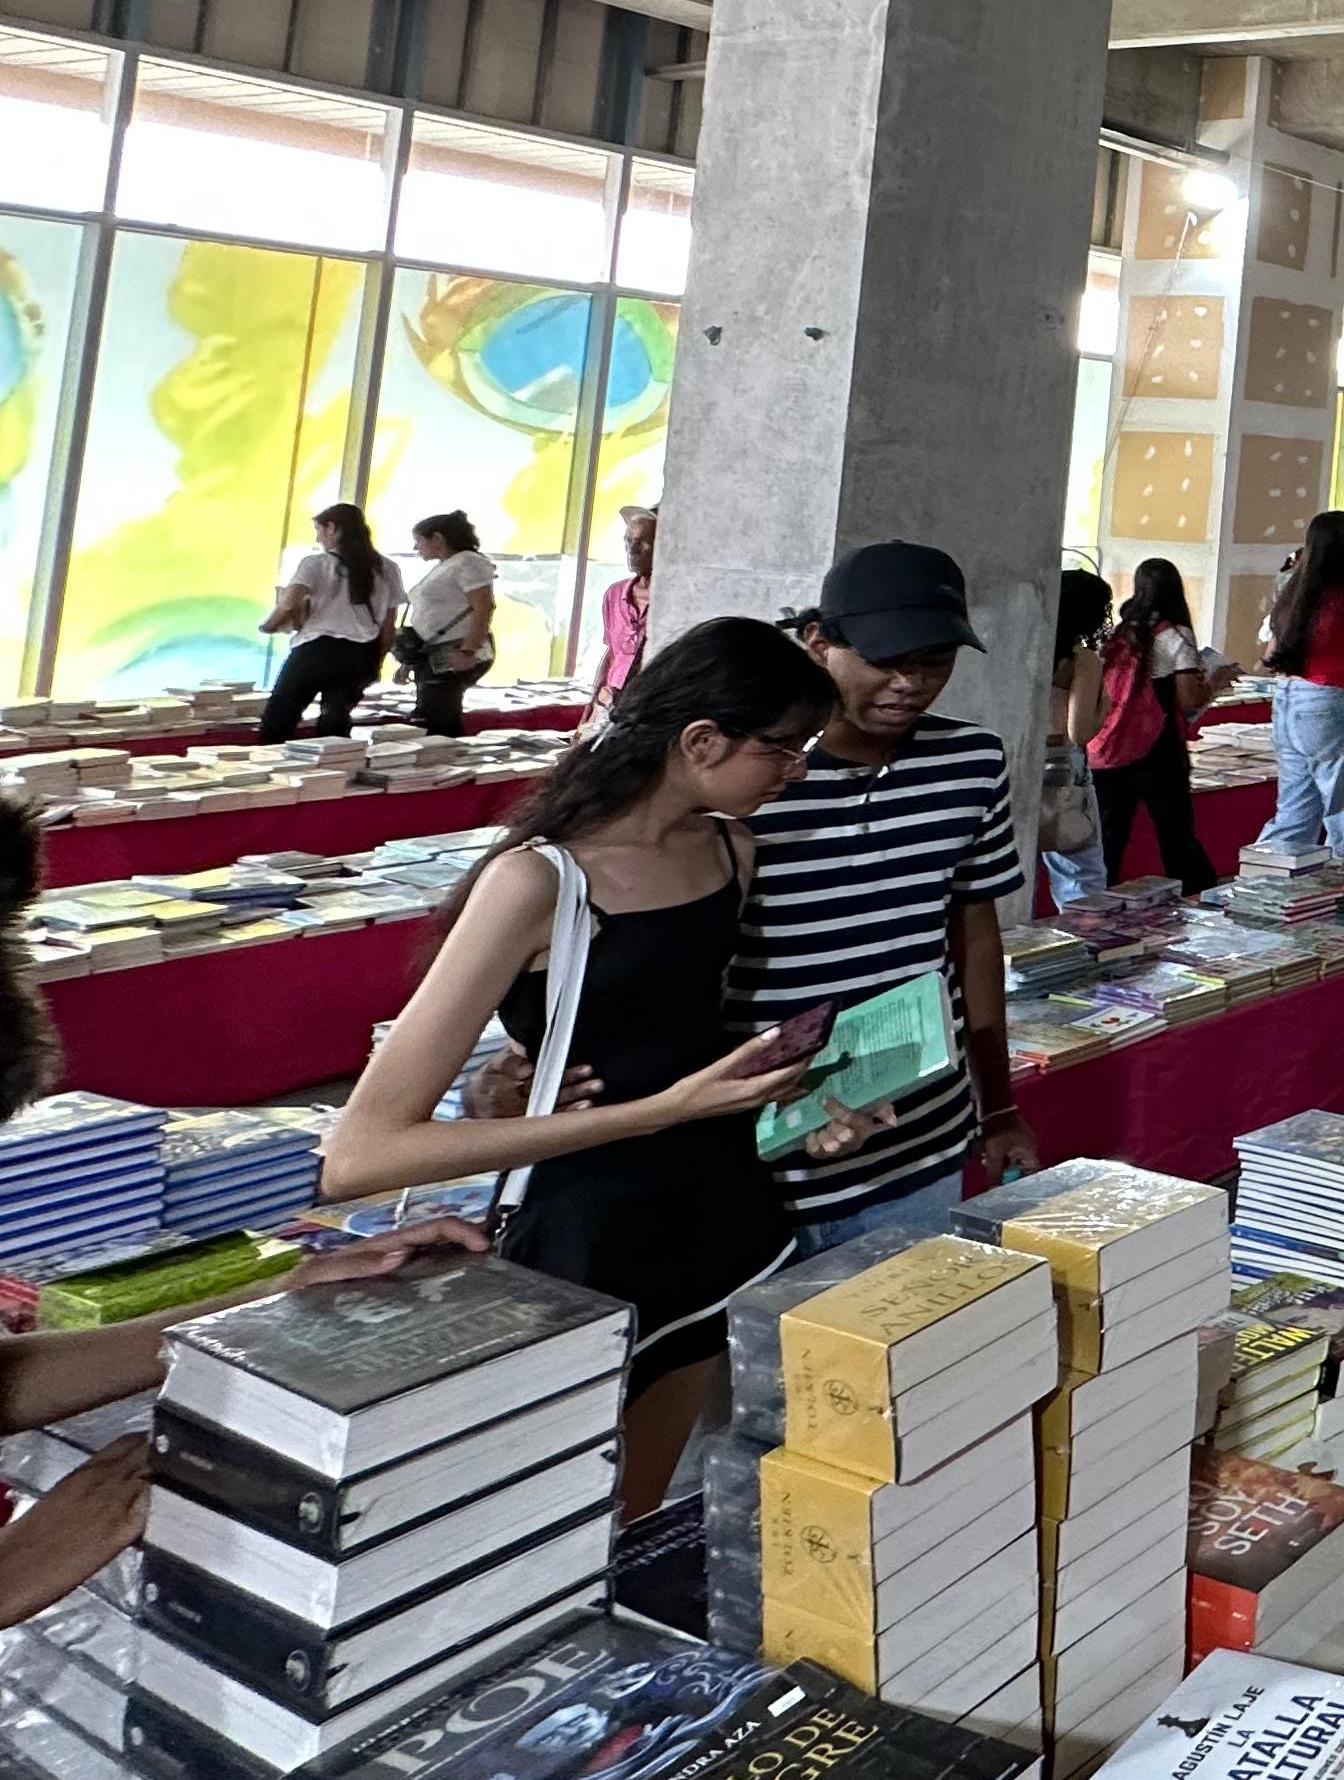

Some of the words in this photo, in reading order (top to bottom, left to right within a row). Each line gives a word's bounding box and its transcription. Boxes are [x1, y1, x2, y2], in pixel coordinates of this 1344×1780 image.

[1202, 1488, 1258, 1537] SOY
[1214, 1491, 1310, 1556] SETH
[374, 1643, 609, 1777] POE
[724, 1719, 762, 1749] AZA
[783, 1708, 846, 1749] DE
[1171, 1721, 1233, 1780] AGUSTÍN
[1223, 1685, 1265, 1722] LAJE
[1227, 1728, 1256, 1749] LA
